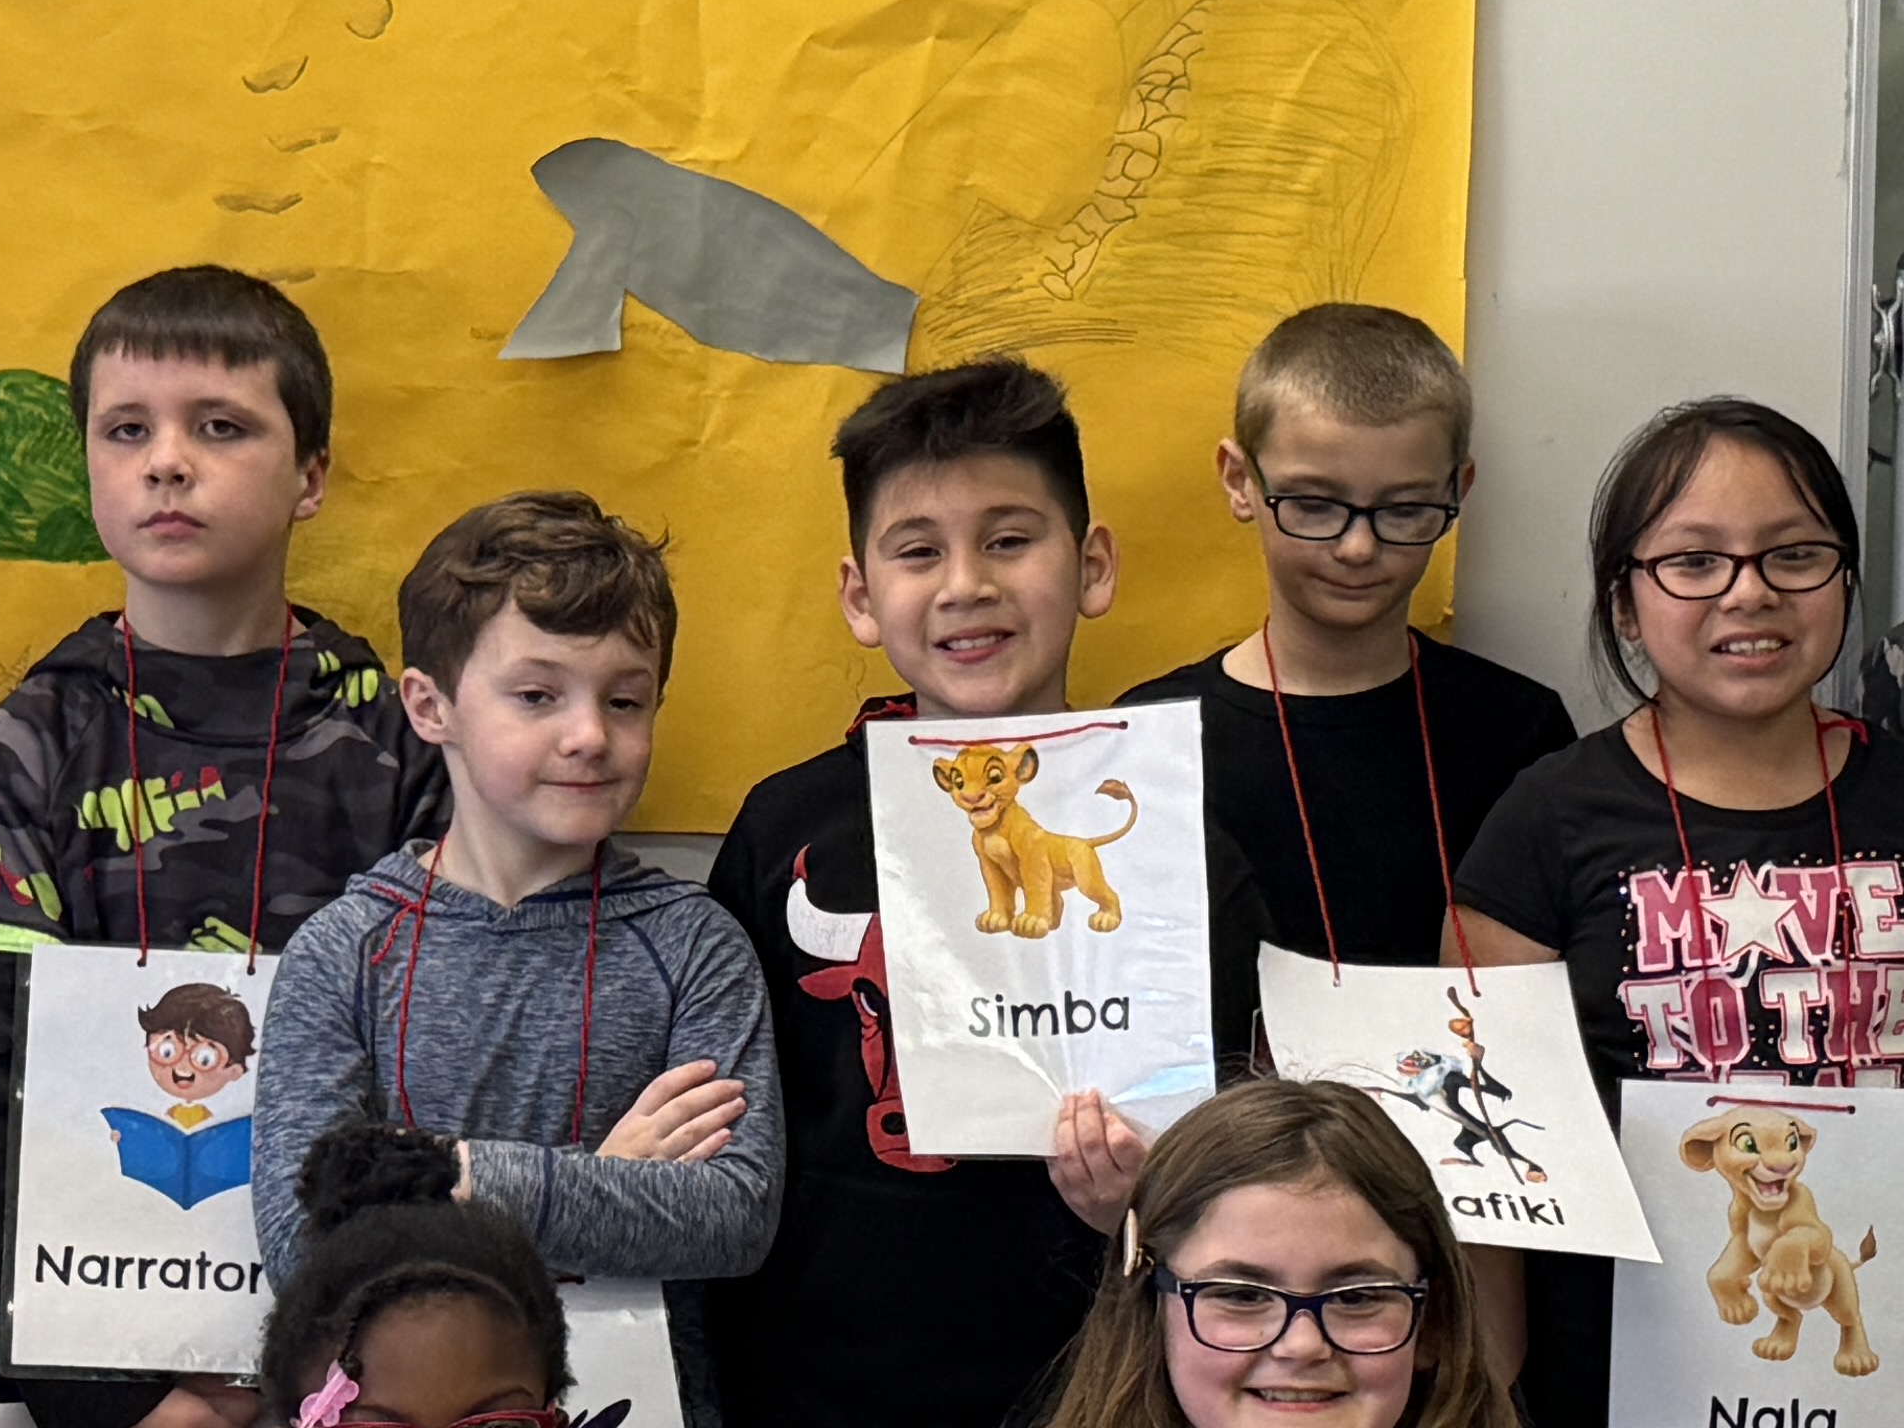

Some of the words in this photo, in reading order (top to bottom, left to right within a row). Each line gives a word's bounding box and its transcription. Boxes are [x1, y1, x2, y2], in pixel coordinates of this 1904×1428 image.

[968, 987, 1130, 1040] Simba
[1617, 974, 1751, 1070] TO
[1452, 1189, 1567, 1229] afiki
[34, 1244, 263, 1296] Narrator
